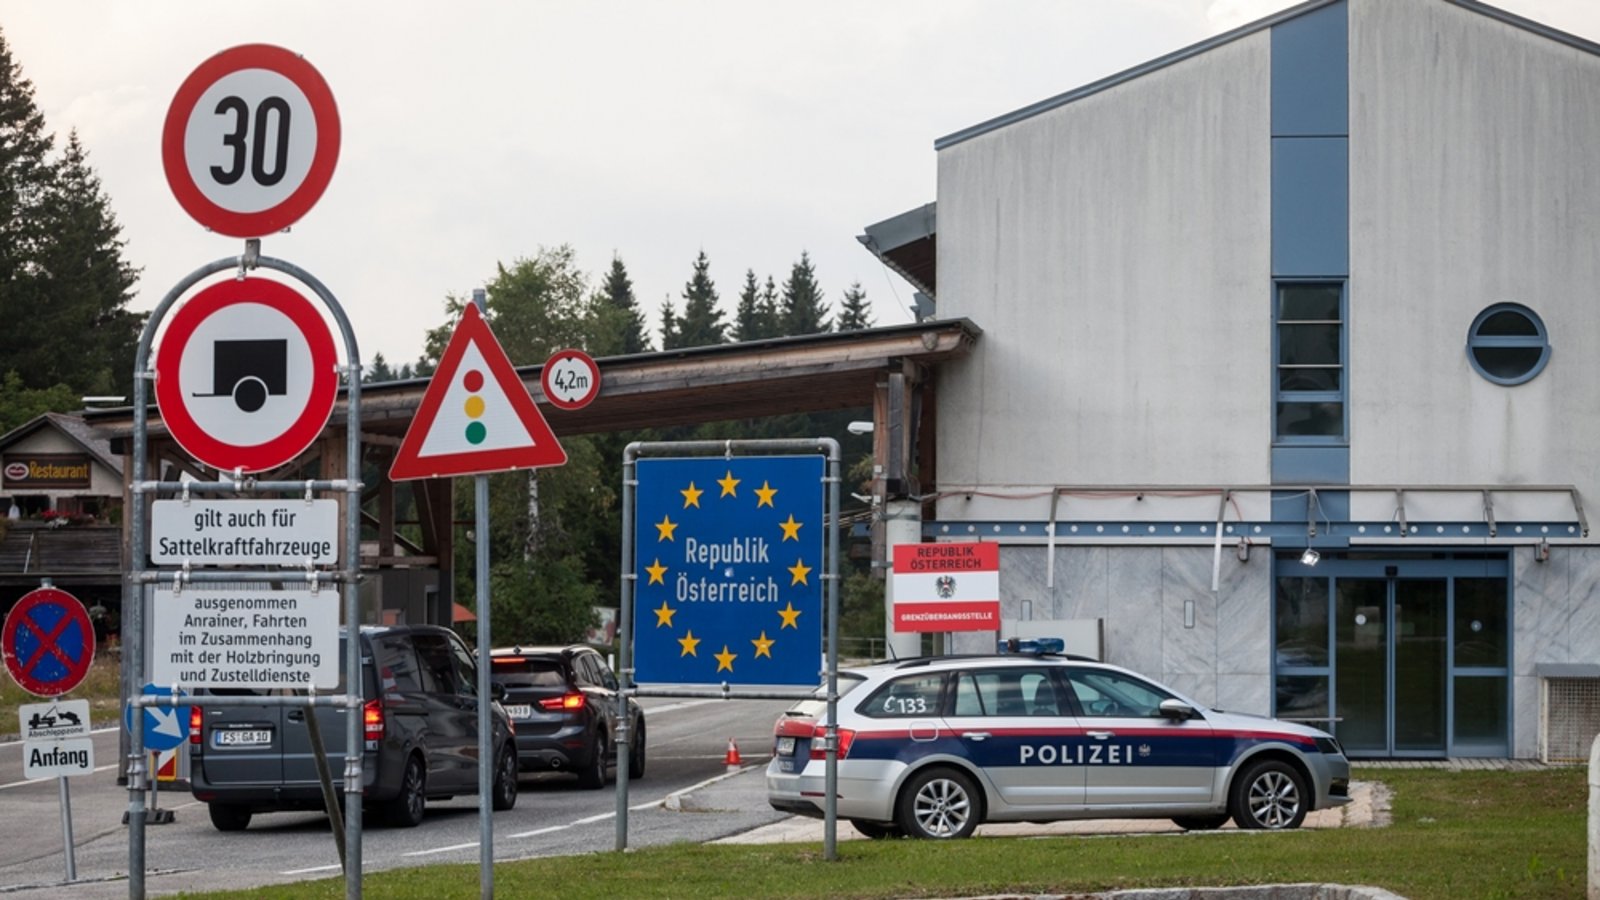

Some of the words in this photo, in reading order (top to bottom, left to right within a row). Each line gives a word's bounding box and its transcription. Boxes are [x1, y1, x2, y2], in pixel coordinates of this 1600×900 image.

[209, 95, 292, 187] 30
[555, 369, 588, 393] 4,2m
[30, 461, 89, 479] Restaurant
[194, 508, 223, 531] gilt
[227, 508, 266, 528] auch
[271, 508, 297, 528] für
[159, 537, 331, 560] Sattelkraftfahrzeuge
[686, 537, 769, 570] Republik
[917, 547, 974, 557] REPUBLIK
[910, 558, 982, 570] ÖSTERREICH
[676, 572, 779, 602] Österreich
[194, 598, 297, 613] ausgenommen
[184, 614, 248, 630] Anrainer,
[252, 614, 307, 628] Fahrten
[901, 612, 993, 622] GRENZÜBERGANGSSTELLE
[179, 632, 196, 646] im
[200, 632, 312, 649] Zusammenhang
[170, 651, 194, 665] mit
[198, 651, 221, 665] der
[226, 651, 321, 667] Holzbringung
[180, 669, 206, 682] und
[210, 669, 311, 683] Zustelldienste
[897, 698, 926, 713] 133
[29, 747, 88, 768] Anfang
[1020, 745, 1133, 764] POLIZEI
